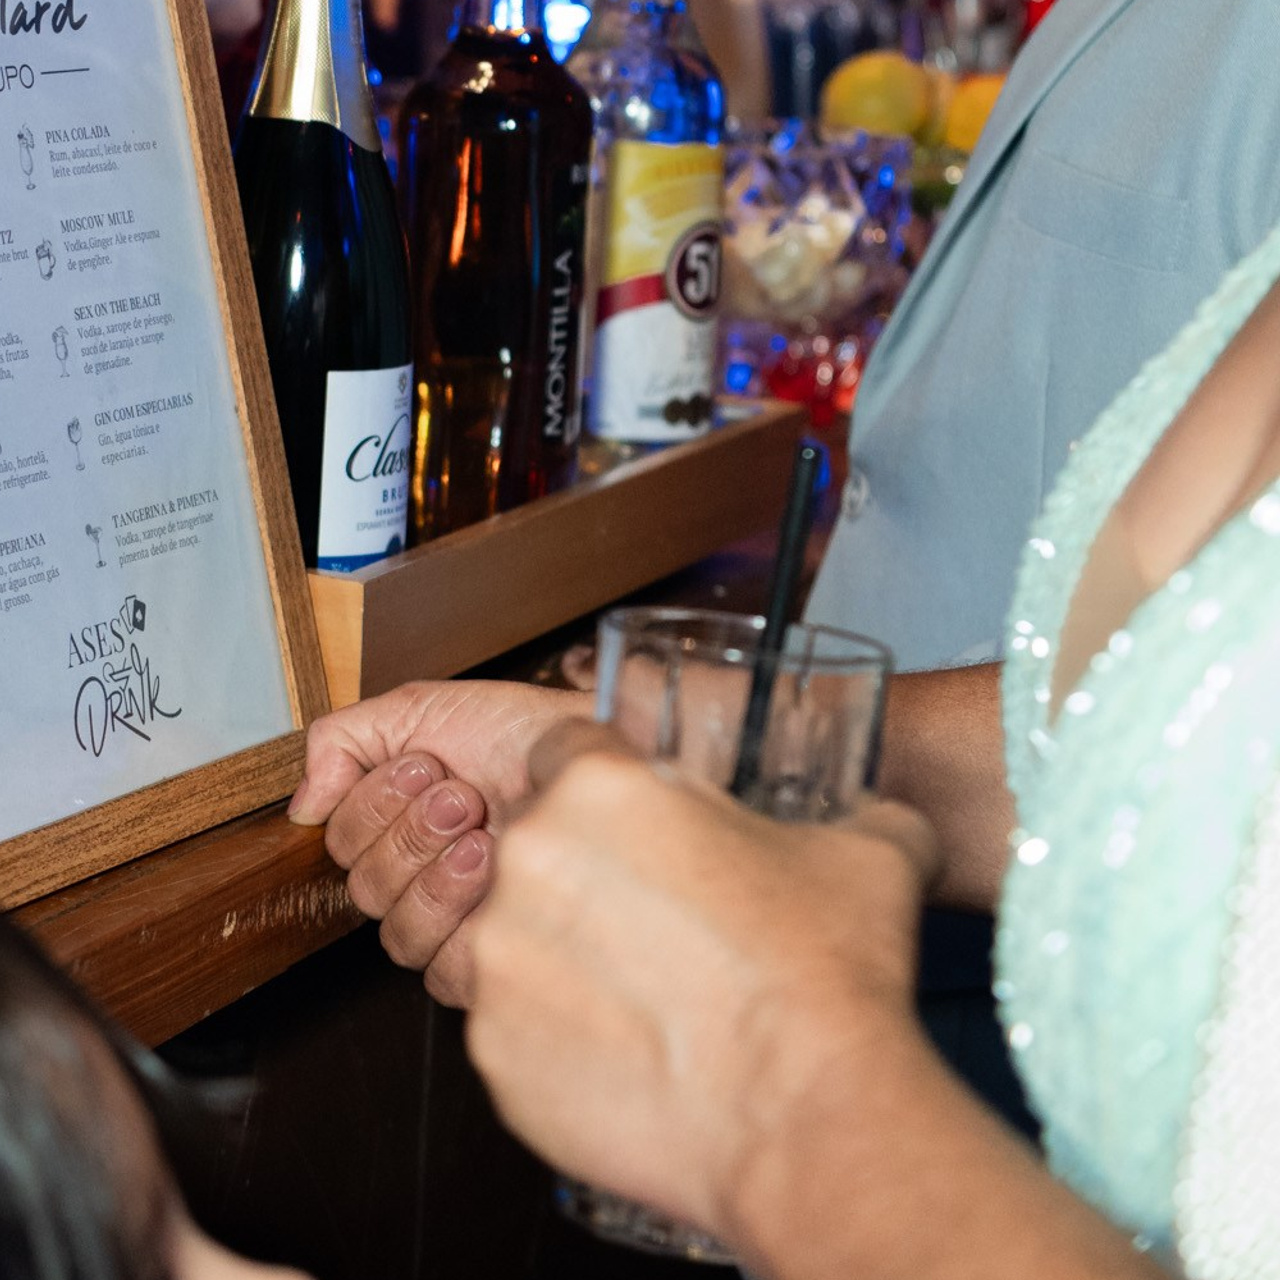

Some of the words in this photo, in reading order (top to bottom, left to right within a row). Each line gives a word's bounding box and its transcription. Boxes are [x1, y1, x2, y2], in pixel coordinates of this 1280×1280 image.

[71, 125, 111, 142] COLADA
[49, 150, 70, 164] Rum,
[105, 142, 122, 156] leite
[122, 140, 132, 153] de
[133, 141, 151, 151] coco
[152, 139, 158, 150] e
[52, 166, 71, 179] leite
[60, 213, 106, 234] MOSCOW
[107, 209, 135, 227] MULE
[128, 233, 133, 243] e
[134, 229, 161, 244] espuma
[12, 247, 30, 261] brut
[67, 258, 77, 271] de
[74, 305, 94, 321] SEX
[94, 302, 108, 318] ON
[109, 298, 129, 314] THE
[129, 292, 162, 310] BEACH
[77, 323, 105, 340] Vodka,
[106, 320, 132, 335] xarope
[132, 317, 142, 329] de
[80, 344, 98, 358] suco
[99, 341, 108, 353] de
[135, 336, 140, 346] e
[544, 250, 573, 437] MONTILLA
[5, 348, 30, 363] frutas
[83, 362, 93, 375] de
[94, 412, 113, 427] GIN
[112, 406, 136, 423] COM
[136, 392, 194, 418] ESPECIARIAS
[155, 423, 160, 433] e
[101, 445, 149, 466] especiarias.
[111, 503, 168, 529] TANGERINA
[168, 500, 176, 514] &
[177, 489, 219, 512] PIMENTA
[115, 531, 142, 548] Vodka,
[167, 520, 176, 534] de
[169, 538, 178, 551] de
[0, 533, 46, 558] PERUANA
[28, 572, 46, 585] com
[4, 593, 33, 613] grosso.
[68, 618, 126, 669] ASES
